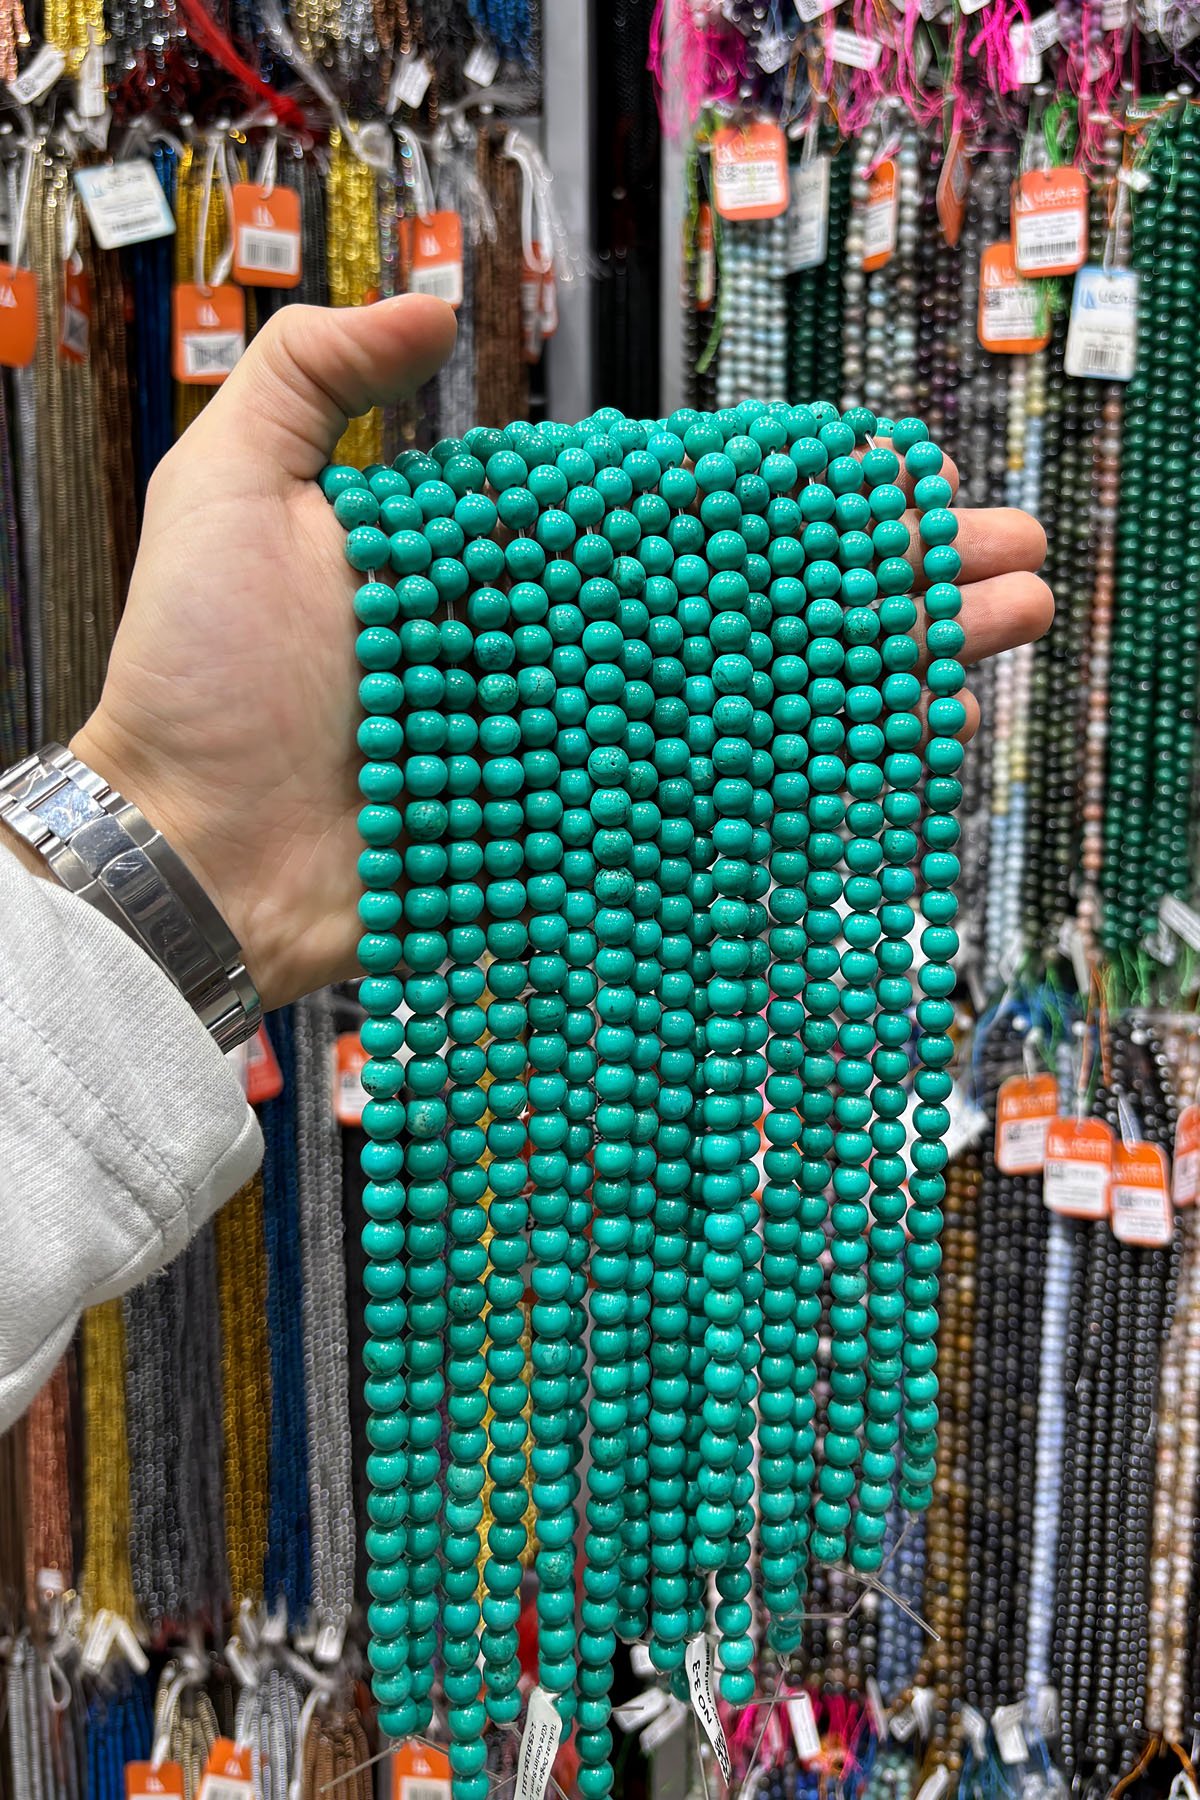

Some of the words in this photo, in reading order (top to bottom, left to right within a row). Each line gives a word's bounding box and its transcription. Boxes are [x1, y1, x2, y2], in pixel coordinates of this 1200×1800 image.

[692, 1659, 701, 1692] 3-3
[698, 1694, 713, 1724] NO
[545, 1723, 557, 1757] Turkuaz
[534, 1743, 544, 1770] Kesim
